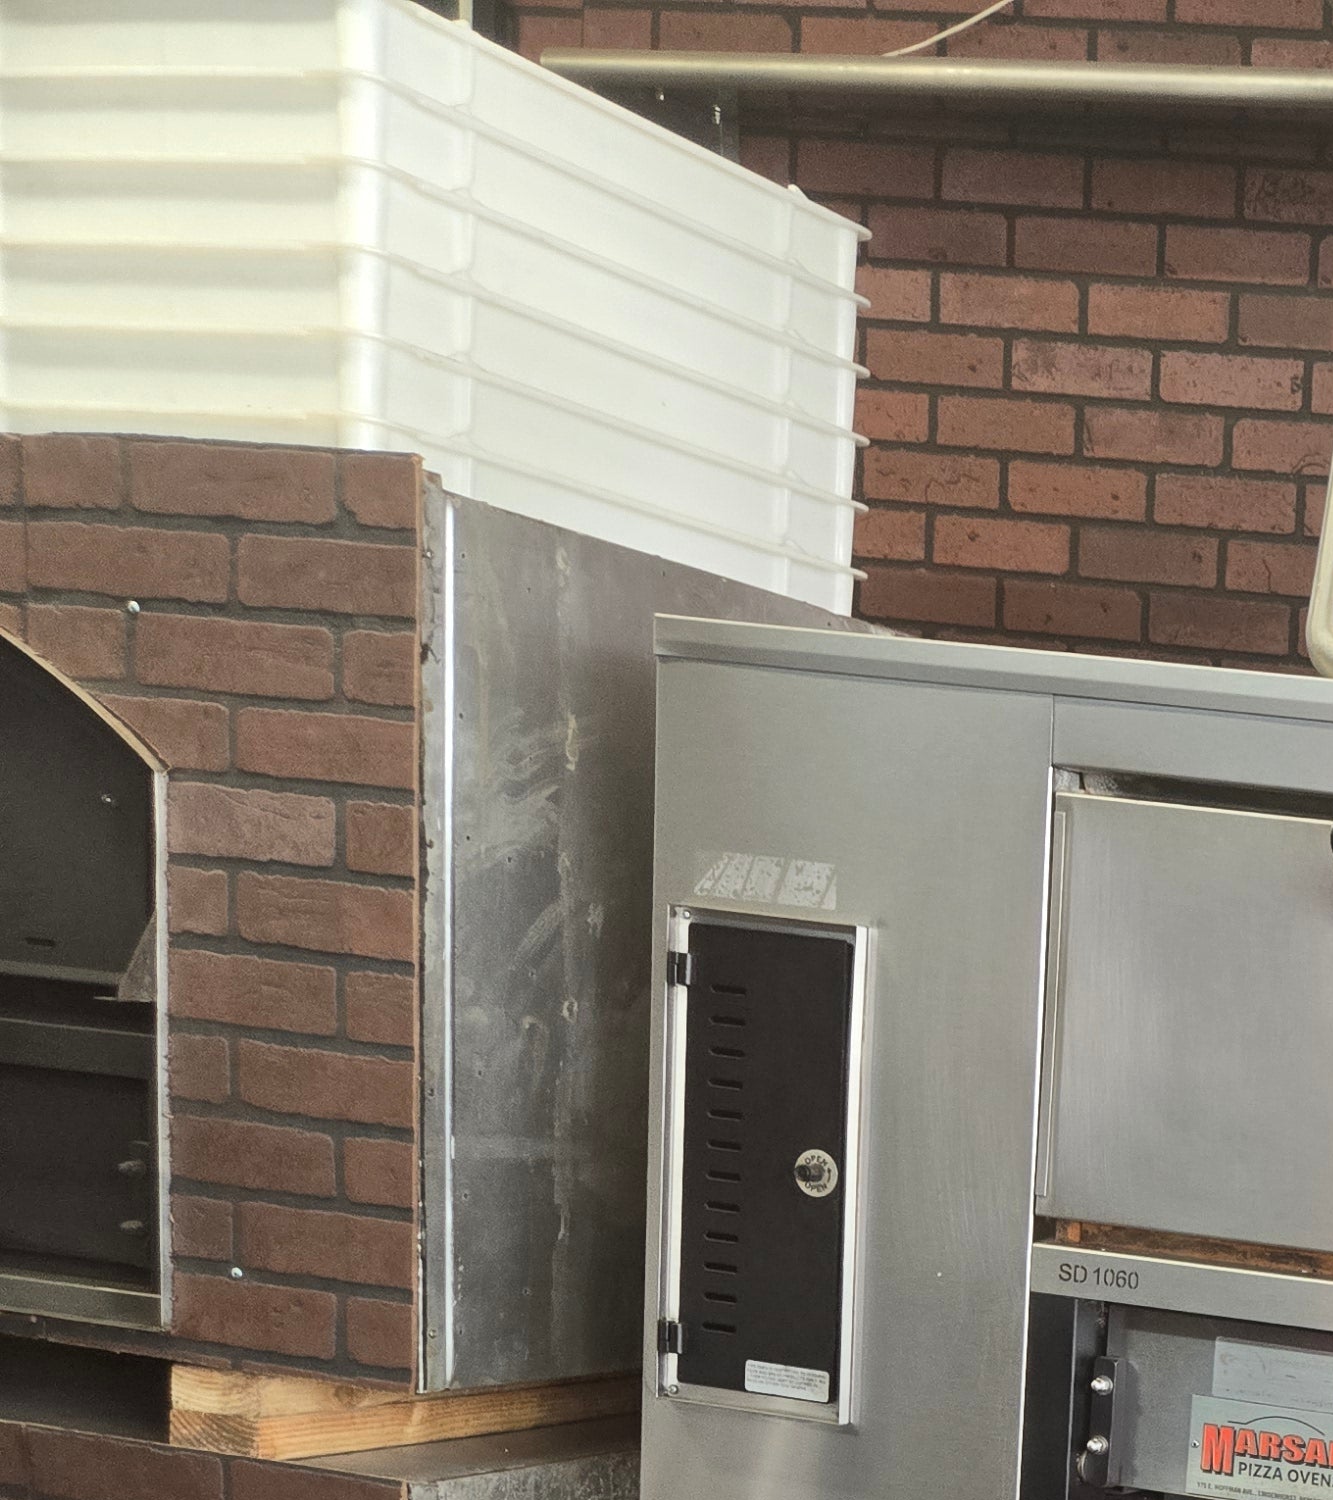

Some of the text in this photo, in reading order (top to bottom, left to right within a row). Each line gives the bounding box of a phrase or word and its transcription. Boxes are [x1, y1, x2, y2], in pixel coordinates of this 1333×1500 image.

[1058, 1263, 1139, 1290] SD 1060
[1237, 1461, 1284, 1482] PIZZA
